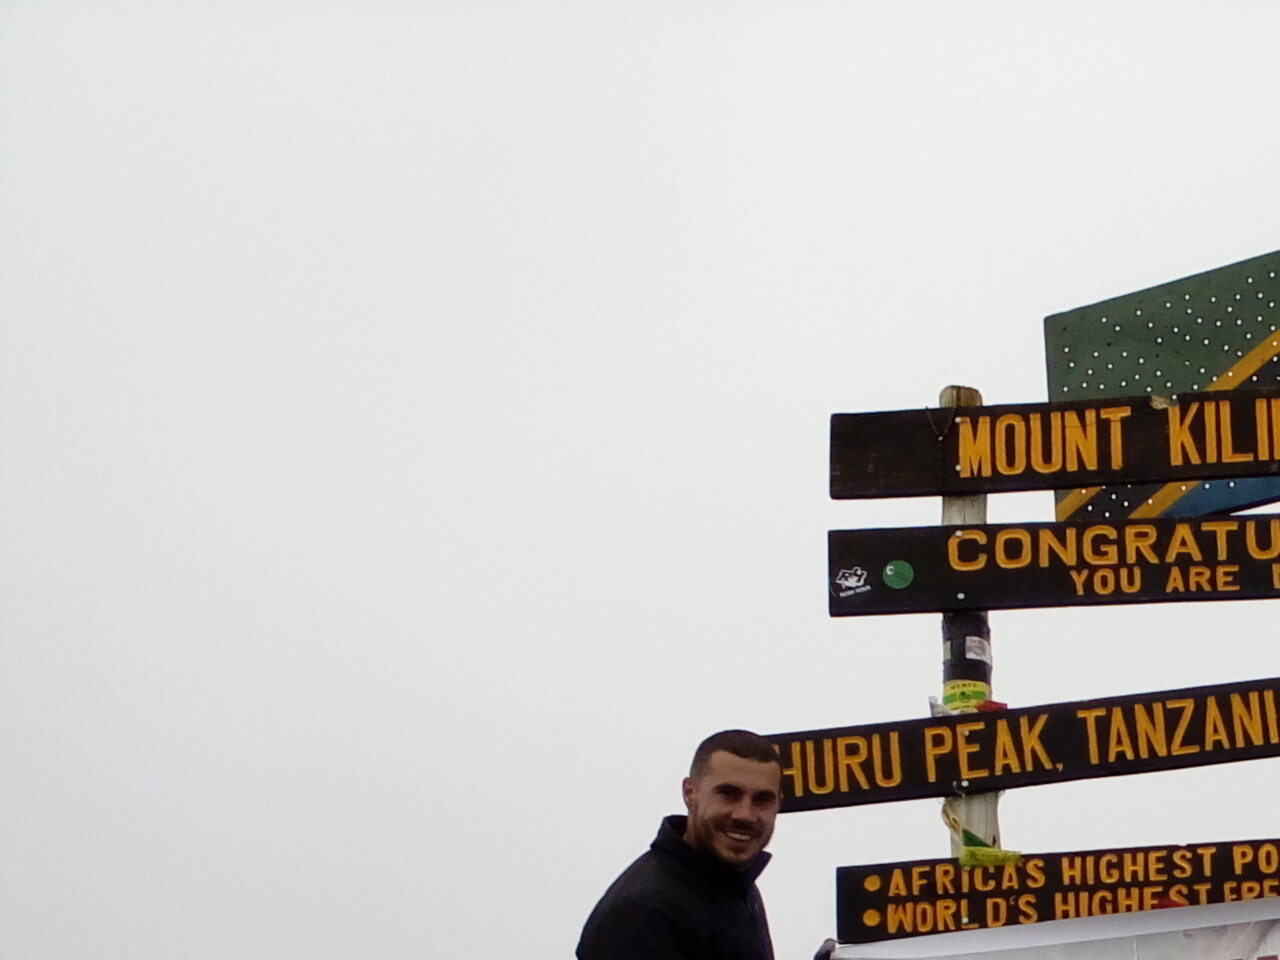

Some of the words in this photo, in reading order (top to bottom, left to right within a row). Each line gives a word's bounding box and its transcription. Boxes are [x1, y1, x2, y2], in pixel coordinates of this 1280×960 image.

[957, 406, 1131, 478] MOUNT
[1070, 567, 1141, 596] YOU
[1166, 564, 1240, 592] ARE
[772, 731, 902, 797] HURU
[924, 714, 1064, 783] PEAK,
[1061, 847, 1216, 886] HIGHEST
[887, 894, 1038, 934] WORLD'S
